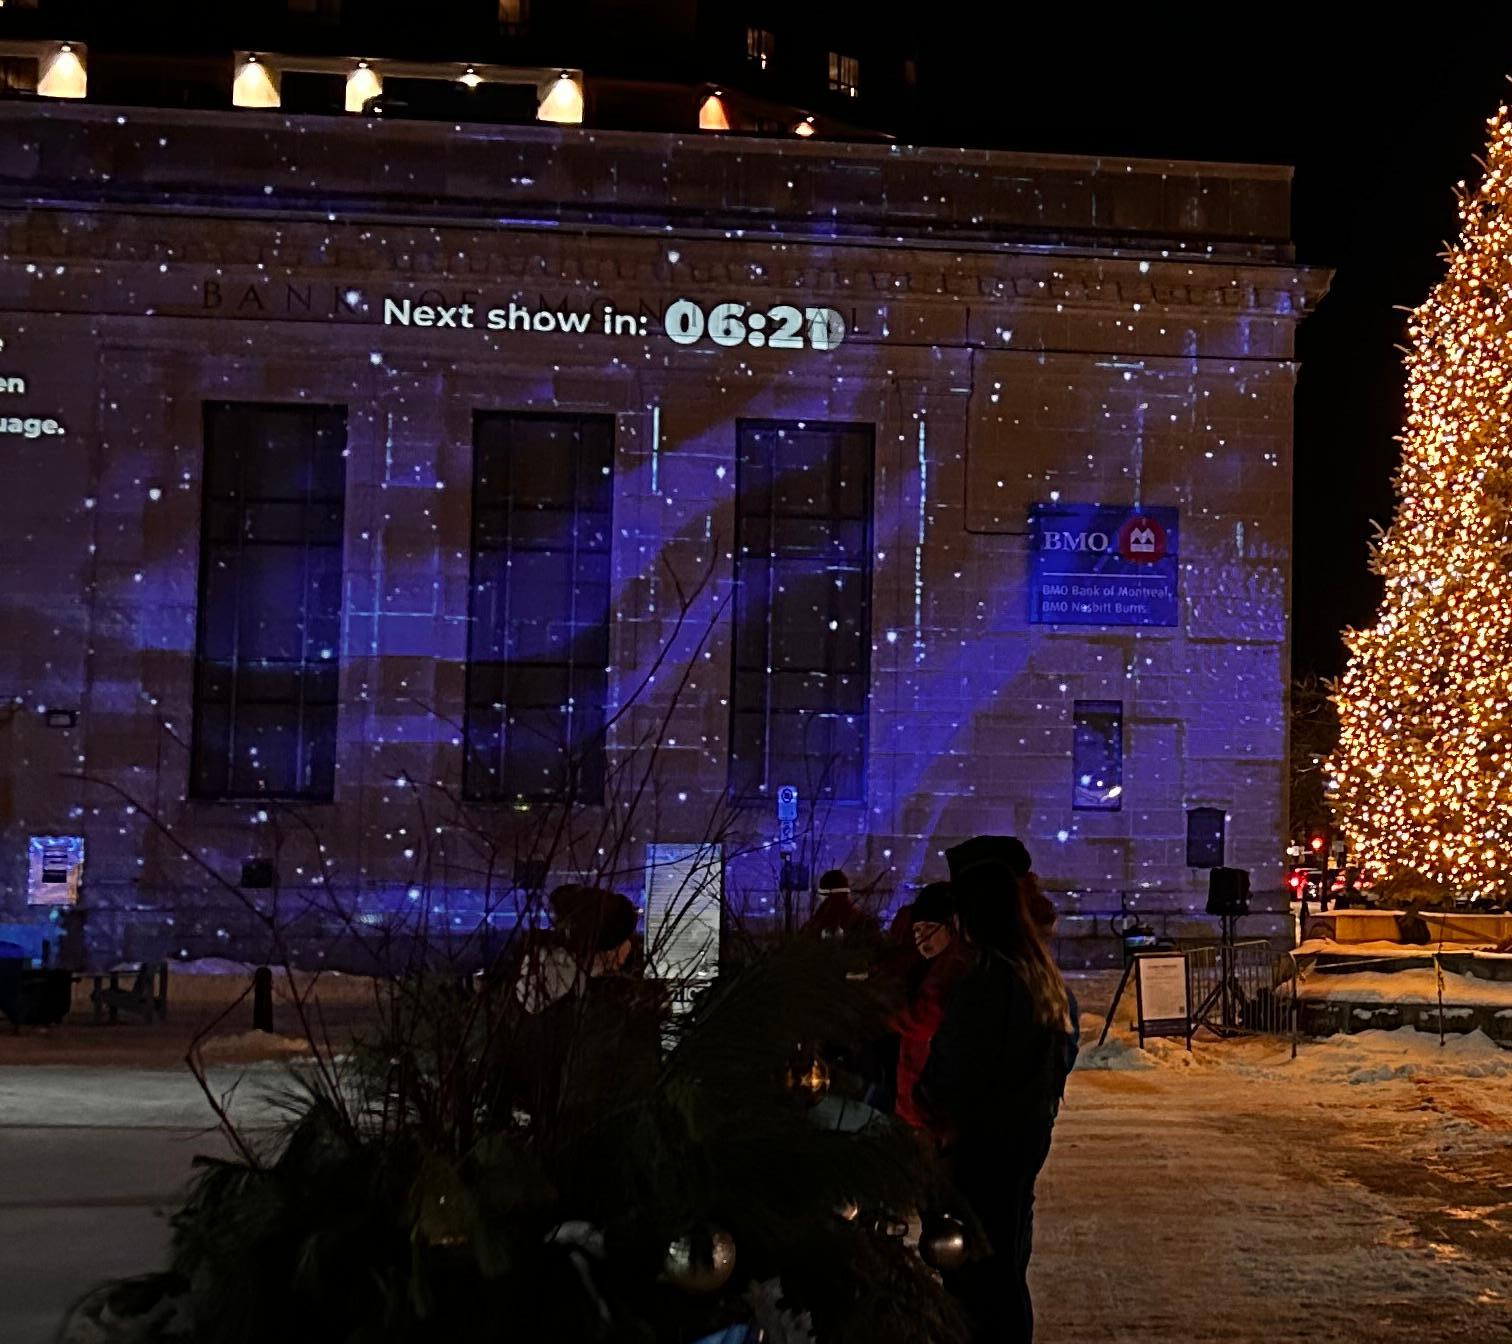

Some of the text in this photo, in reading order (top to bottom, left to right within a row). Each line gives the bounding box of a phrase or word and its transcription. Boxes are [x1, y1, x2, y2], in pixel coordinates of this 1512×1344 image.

[203, 280, 356, 314] BANK
[384, 298, 474, 328] Next
[487, 303, 591, 333] show
[604, 306, 647, 336] in:
[1043, 531, 1109, 552] BMO
[1042, 585, 1069, 596] BMO
[1072, 585, 1100, 597] Bank
[1103, 585, 1115, 596] of
[1042, 601, 1068, 612] BMO
[1115, 603, 1147, 614] Burns
